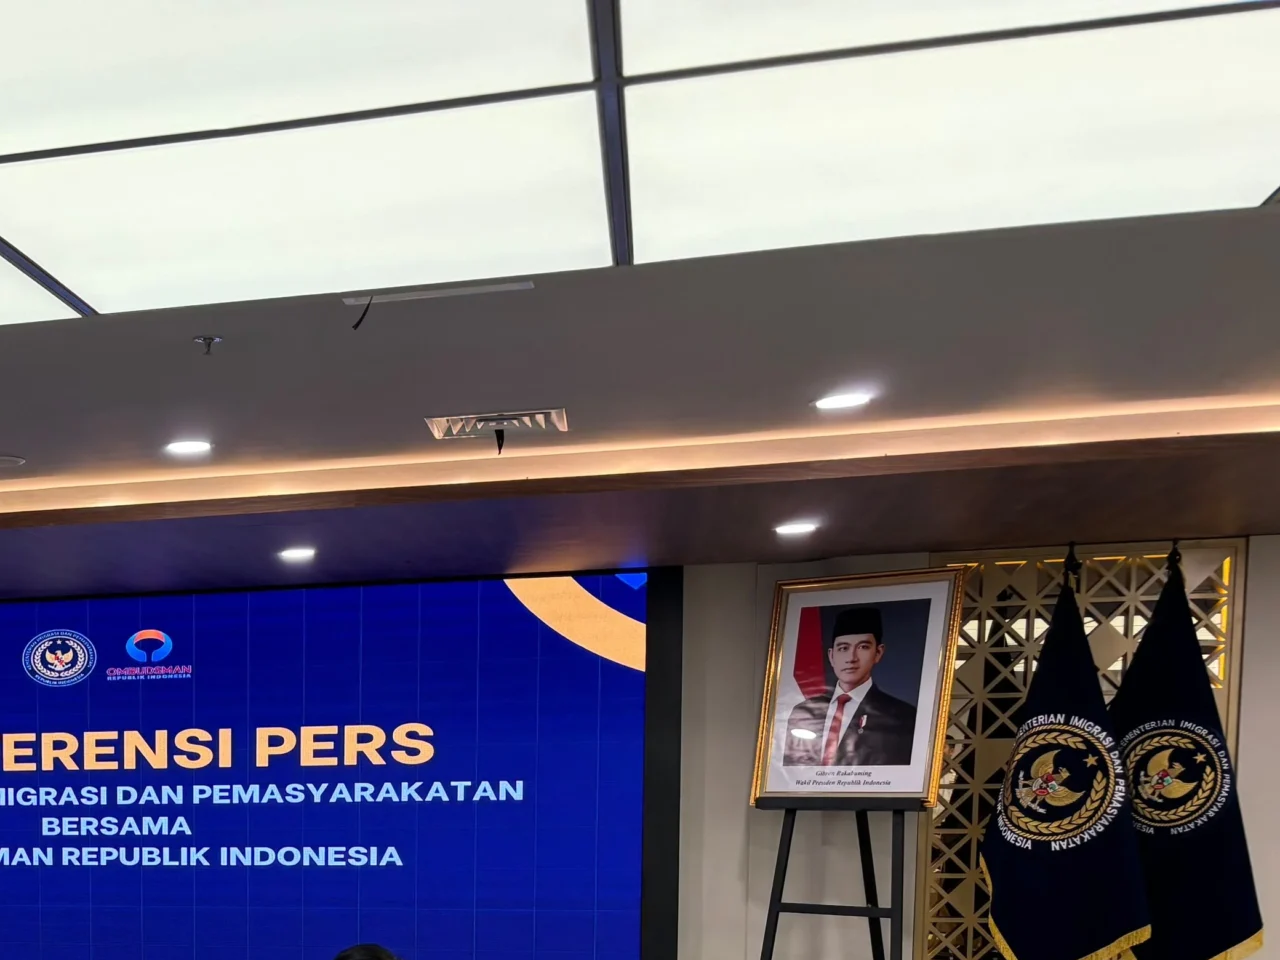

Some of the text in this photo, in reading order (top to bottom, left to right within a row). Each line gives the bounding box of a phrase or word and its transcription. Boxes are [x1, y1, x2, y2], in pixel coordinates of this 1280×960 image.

[106, 665, 192, 676] OMBUDSMAN
[255, 722, 435, 768] PERS
[1180, 720, 1222, 748] IMIGRASI
[1218, 750, 1230, 770] DAN
[116, 785, 184, 805] DAN
[192, 780, 524, 805] PEMASYARAKATAN
[1018, 713, 1126, 852] ENTERIAN IMIGRASI DAN PEMASYARAKATAN
[1170, 773, 1231, 835] PEMASYARAKATAN
[41, 816, 193, 836] BERSAMA
[61, 847, 211, 866] REPUBLIK
[220, 846, 404, 866] INDONESIA
